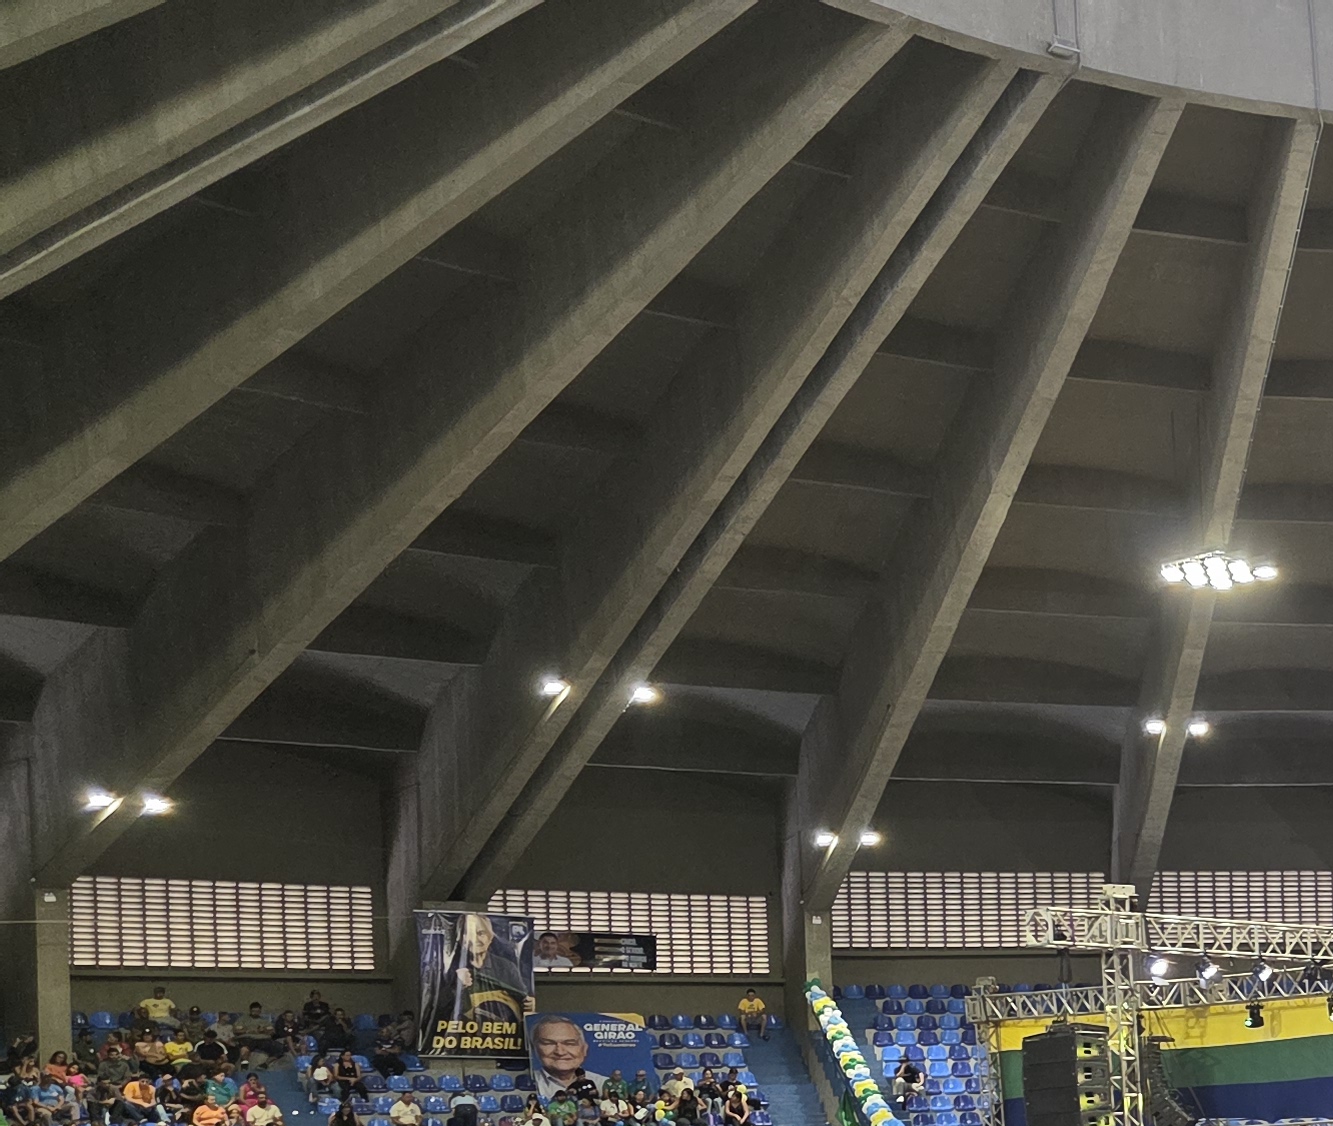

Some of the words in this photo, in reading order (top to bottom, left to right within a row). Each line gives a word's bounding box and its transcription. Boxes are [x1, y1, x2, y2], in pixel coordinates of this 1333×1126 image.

[436, 1020, 478, 1034] PELO
[481, 1021, 517, 1035] BEM
[583, 1022, 644, 1033] GENERAL
[432, 1035, 457, 1050] DO
[459, 1036, 522, 1051] BRASIL!
